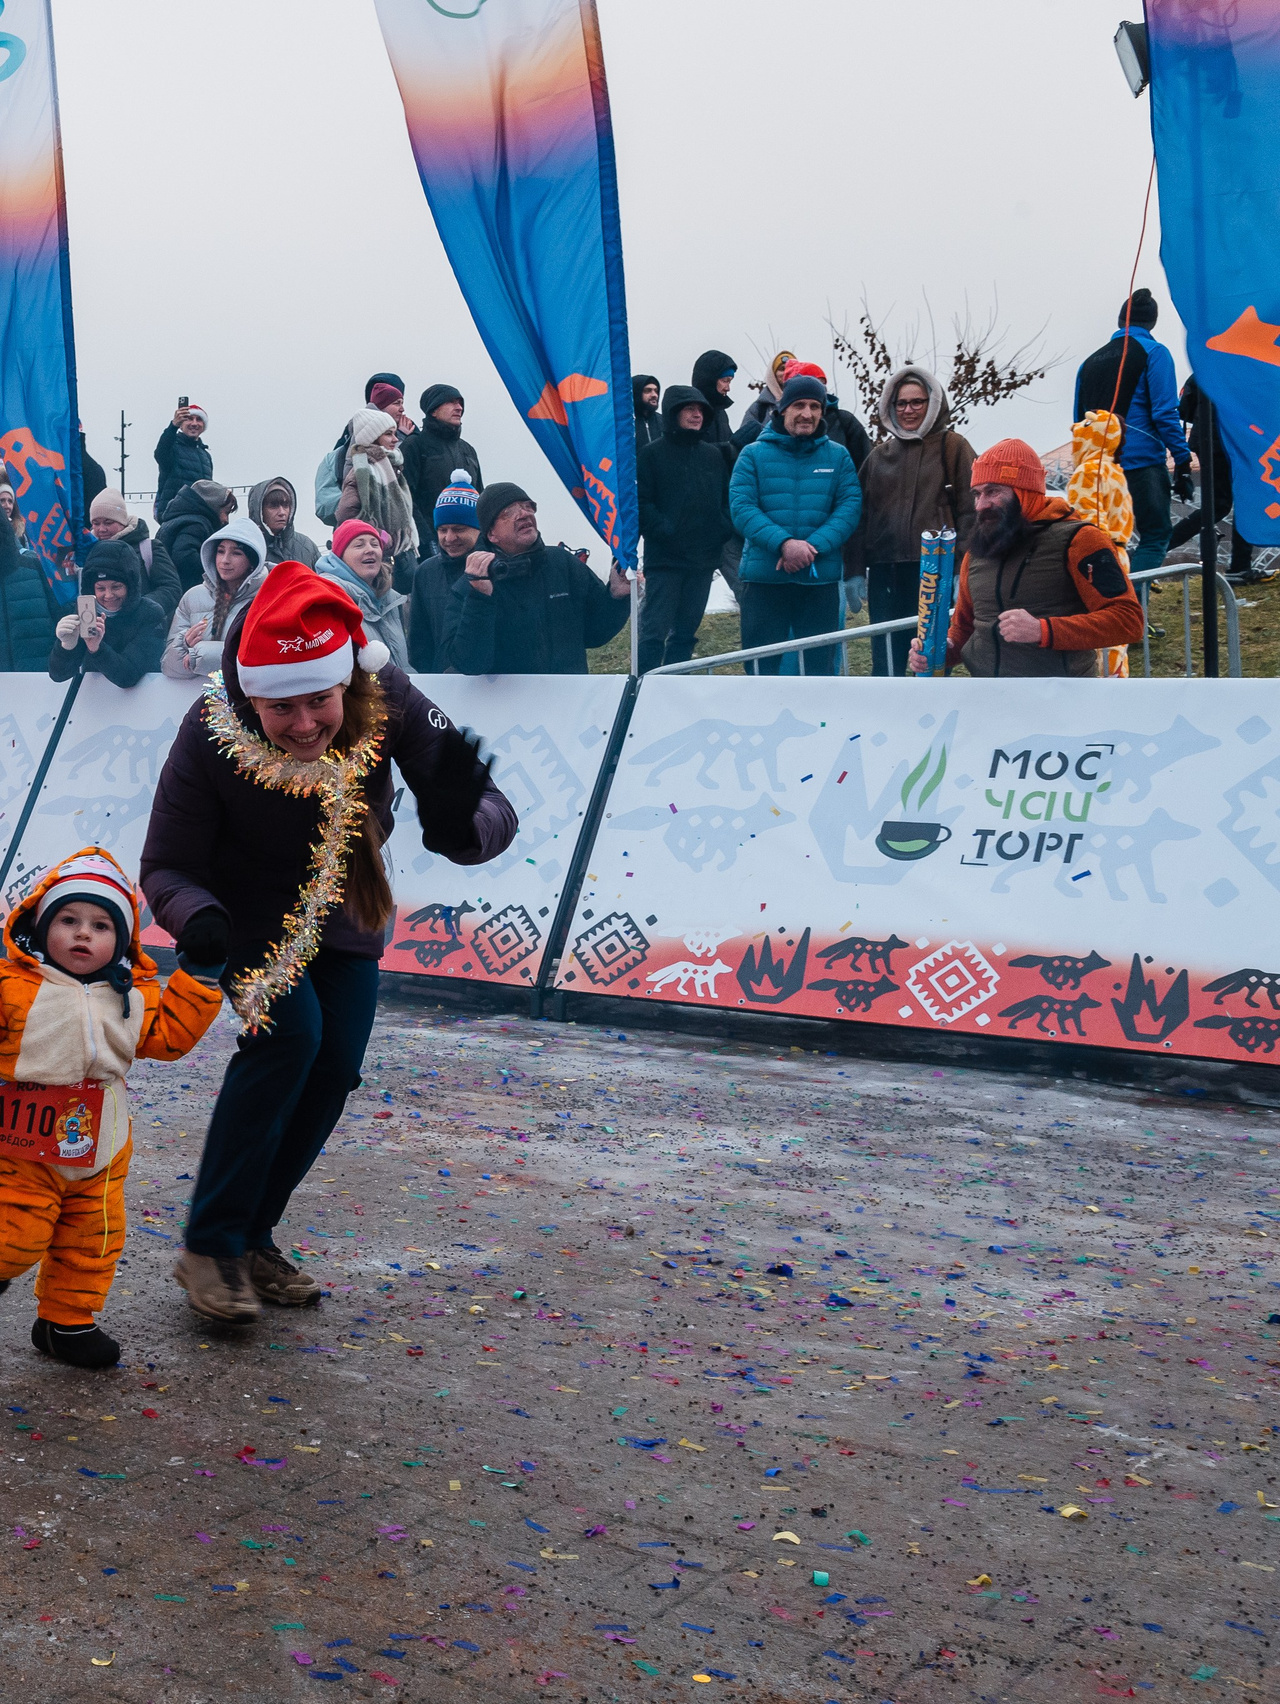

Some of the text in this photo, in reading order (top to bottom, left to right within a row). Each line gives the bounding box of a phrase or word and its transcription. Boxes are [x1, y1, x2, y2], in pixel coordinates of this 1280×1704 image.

[459, 497, 478, 507] ULT
[305, 637, 320, 650] MAD
[988, 748, 1102, 781] МОС
[975, 828, 1084, 864] ТОРГ
